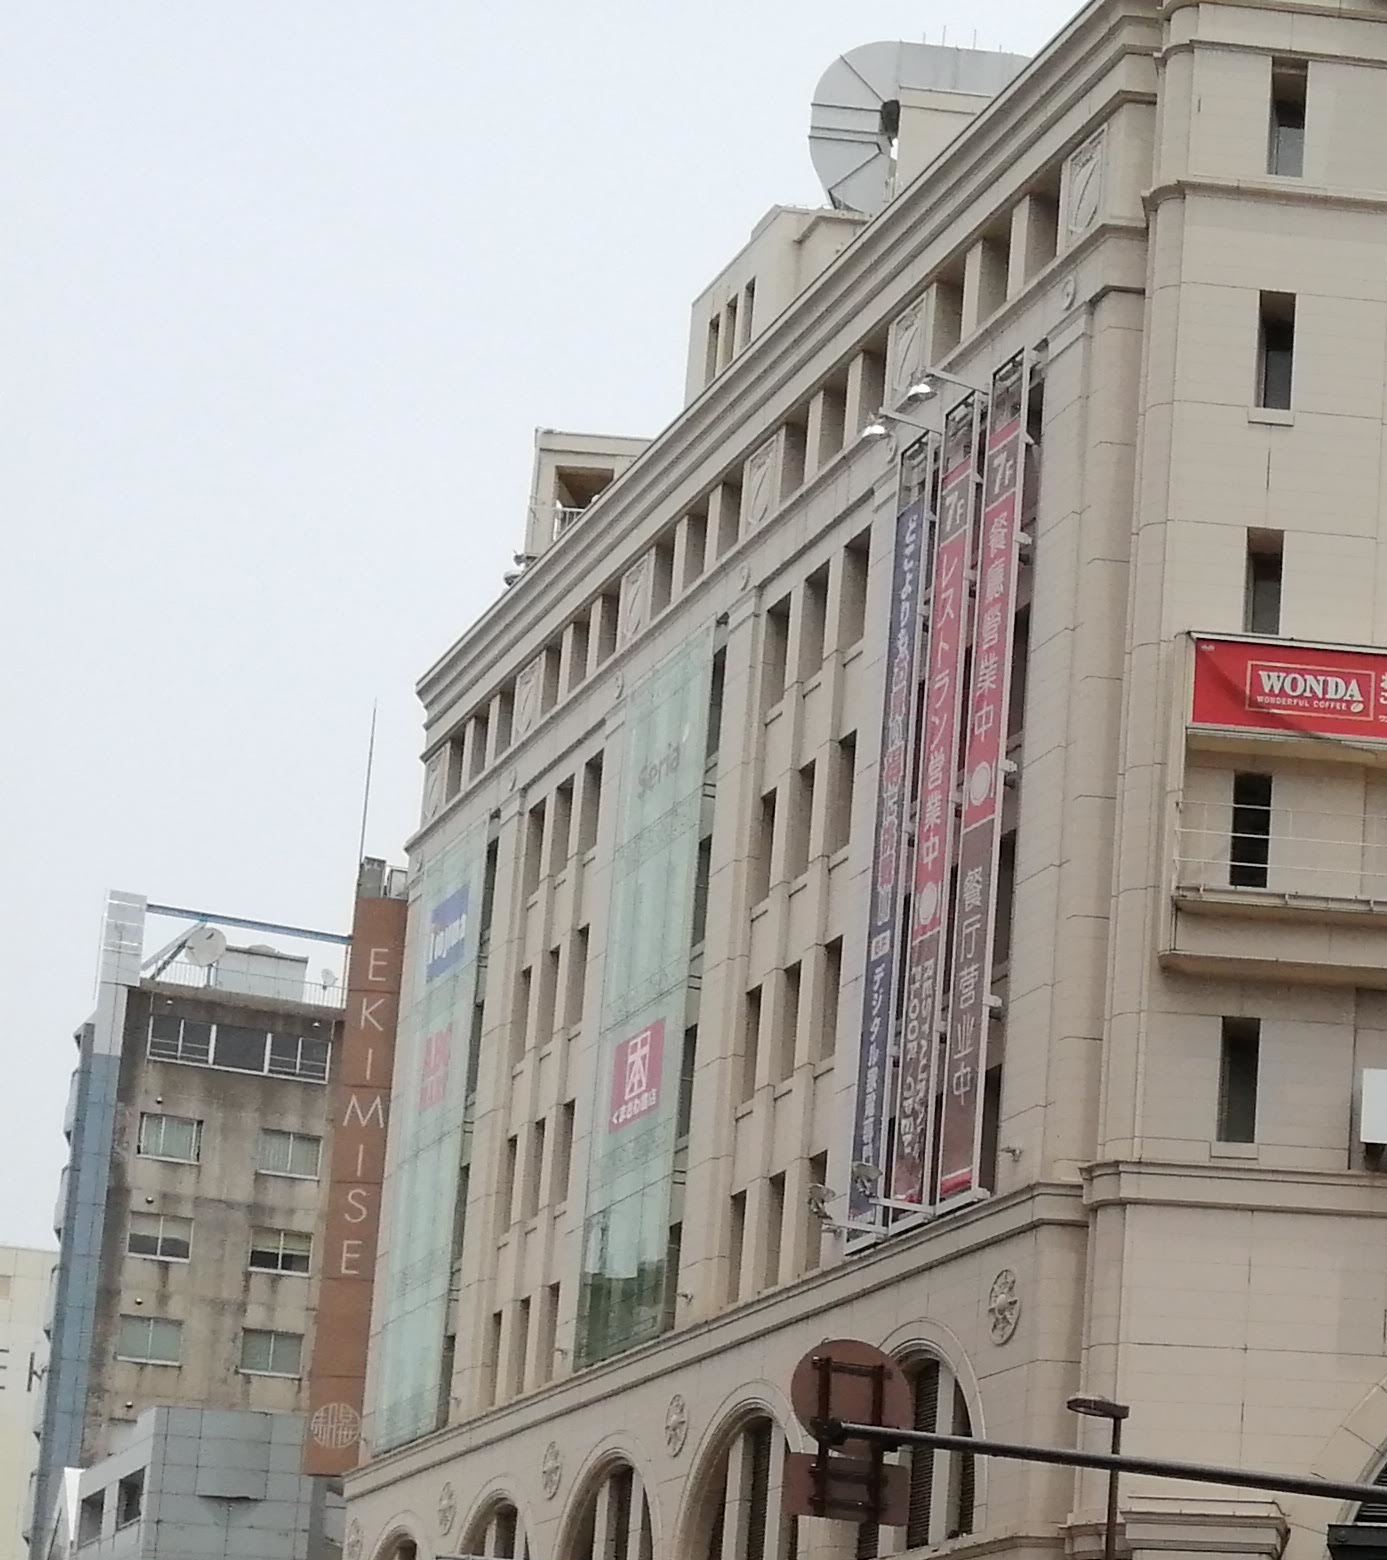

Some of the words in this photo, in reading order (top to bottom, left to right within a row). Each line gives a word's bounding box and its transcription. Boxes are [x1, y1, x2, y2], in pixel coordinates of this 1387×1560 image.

[945, 495, 965, 532] 7F
[991, 455, 1014, 496] 7F
[920, 552, 960, 873] レストラン営業中
[1257, 695, 1310, 708] WONDERFUL
[1313, 701, 1347, 711] COFFEE
[1258, 671, 1364, 702] WONDA
[904, 965, 922, 1059] FLOOR
[953, 867, 984, 1106] 餐厅营业中
[340, 946, 390, 1276] EKIMISE
[899, 1076, 915, 1157] OPEN
